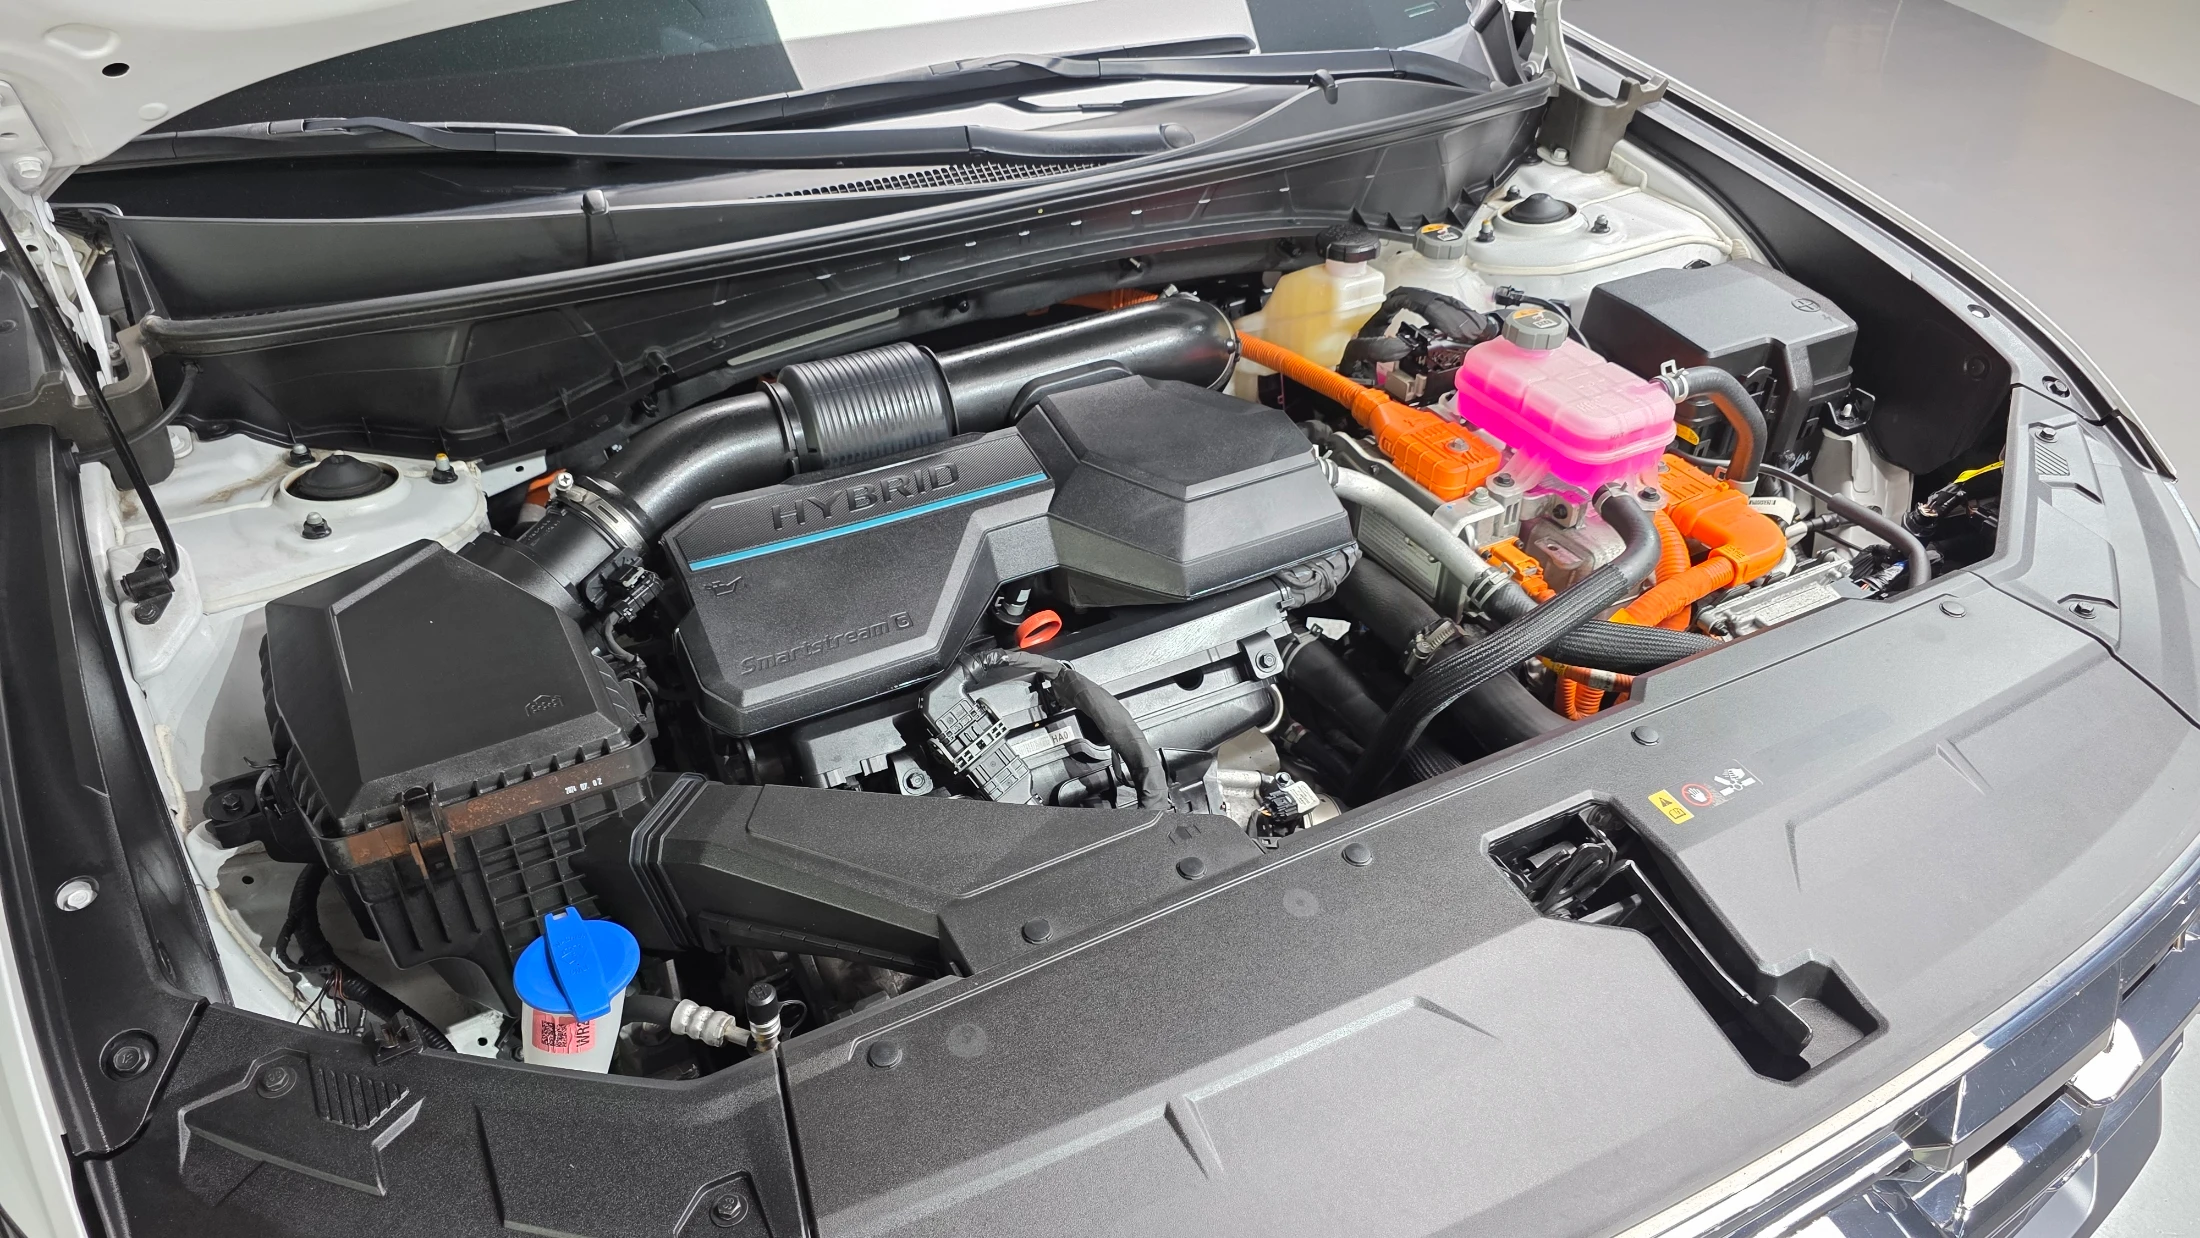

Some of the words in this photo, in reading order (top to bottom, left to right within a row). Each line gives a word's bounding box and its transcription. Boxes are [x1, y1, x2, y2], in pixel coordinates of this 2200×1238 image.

[772, 463, 960, 531] HYBRID
[740, 622, 890, 675] Smartstream
[890, 611, 914, 630] G
